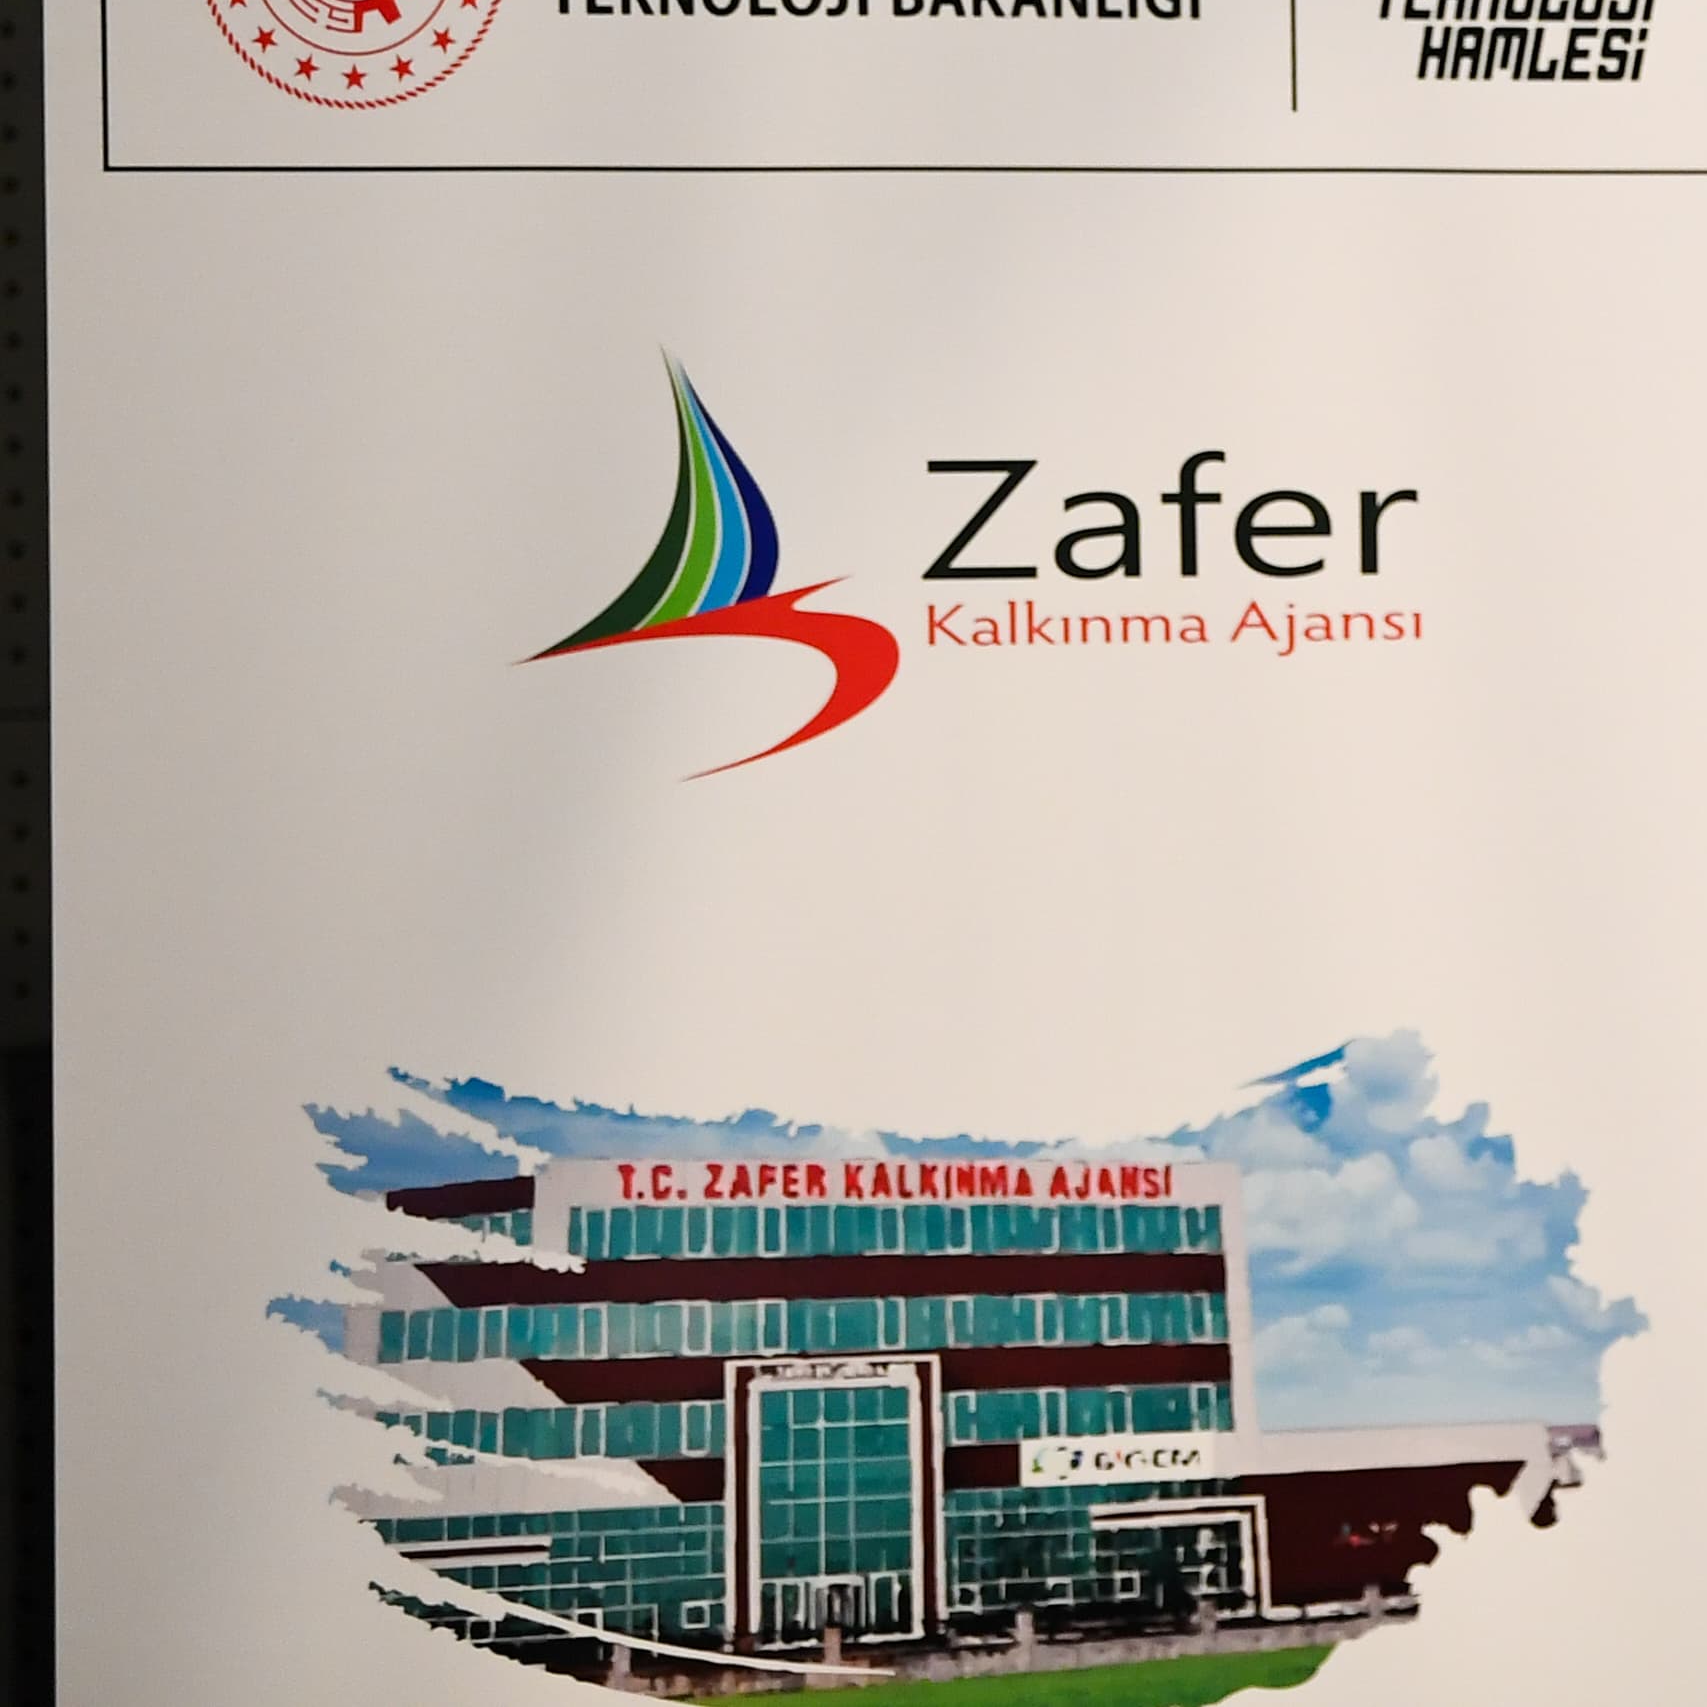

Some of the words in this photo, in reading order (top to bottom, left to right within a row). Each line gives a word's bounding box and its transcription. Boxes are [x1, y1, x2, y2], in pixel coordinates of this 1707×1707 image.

[920, 450, 1418, 580] Zafer
[925, 602, 1208, 648] Kalkınma
[1230, 600, 1424, 656] Ajansı
[617, 1163, 688, 1200] T.C.
[704, 1162, 829, 1199] ZAFER
[843, 1161, 1033, 1199] KALKINMA
[1049, 1162, 1173, 1199] AJANSI
